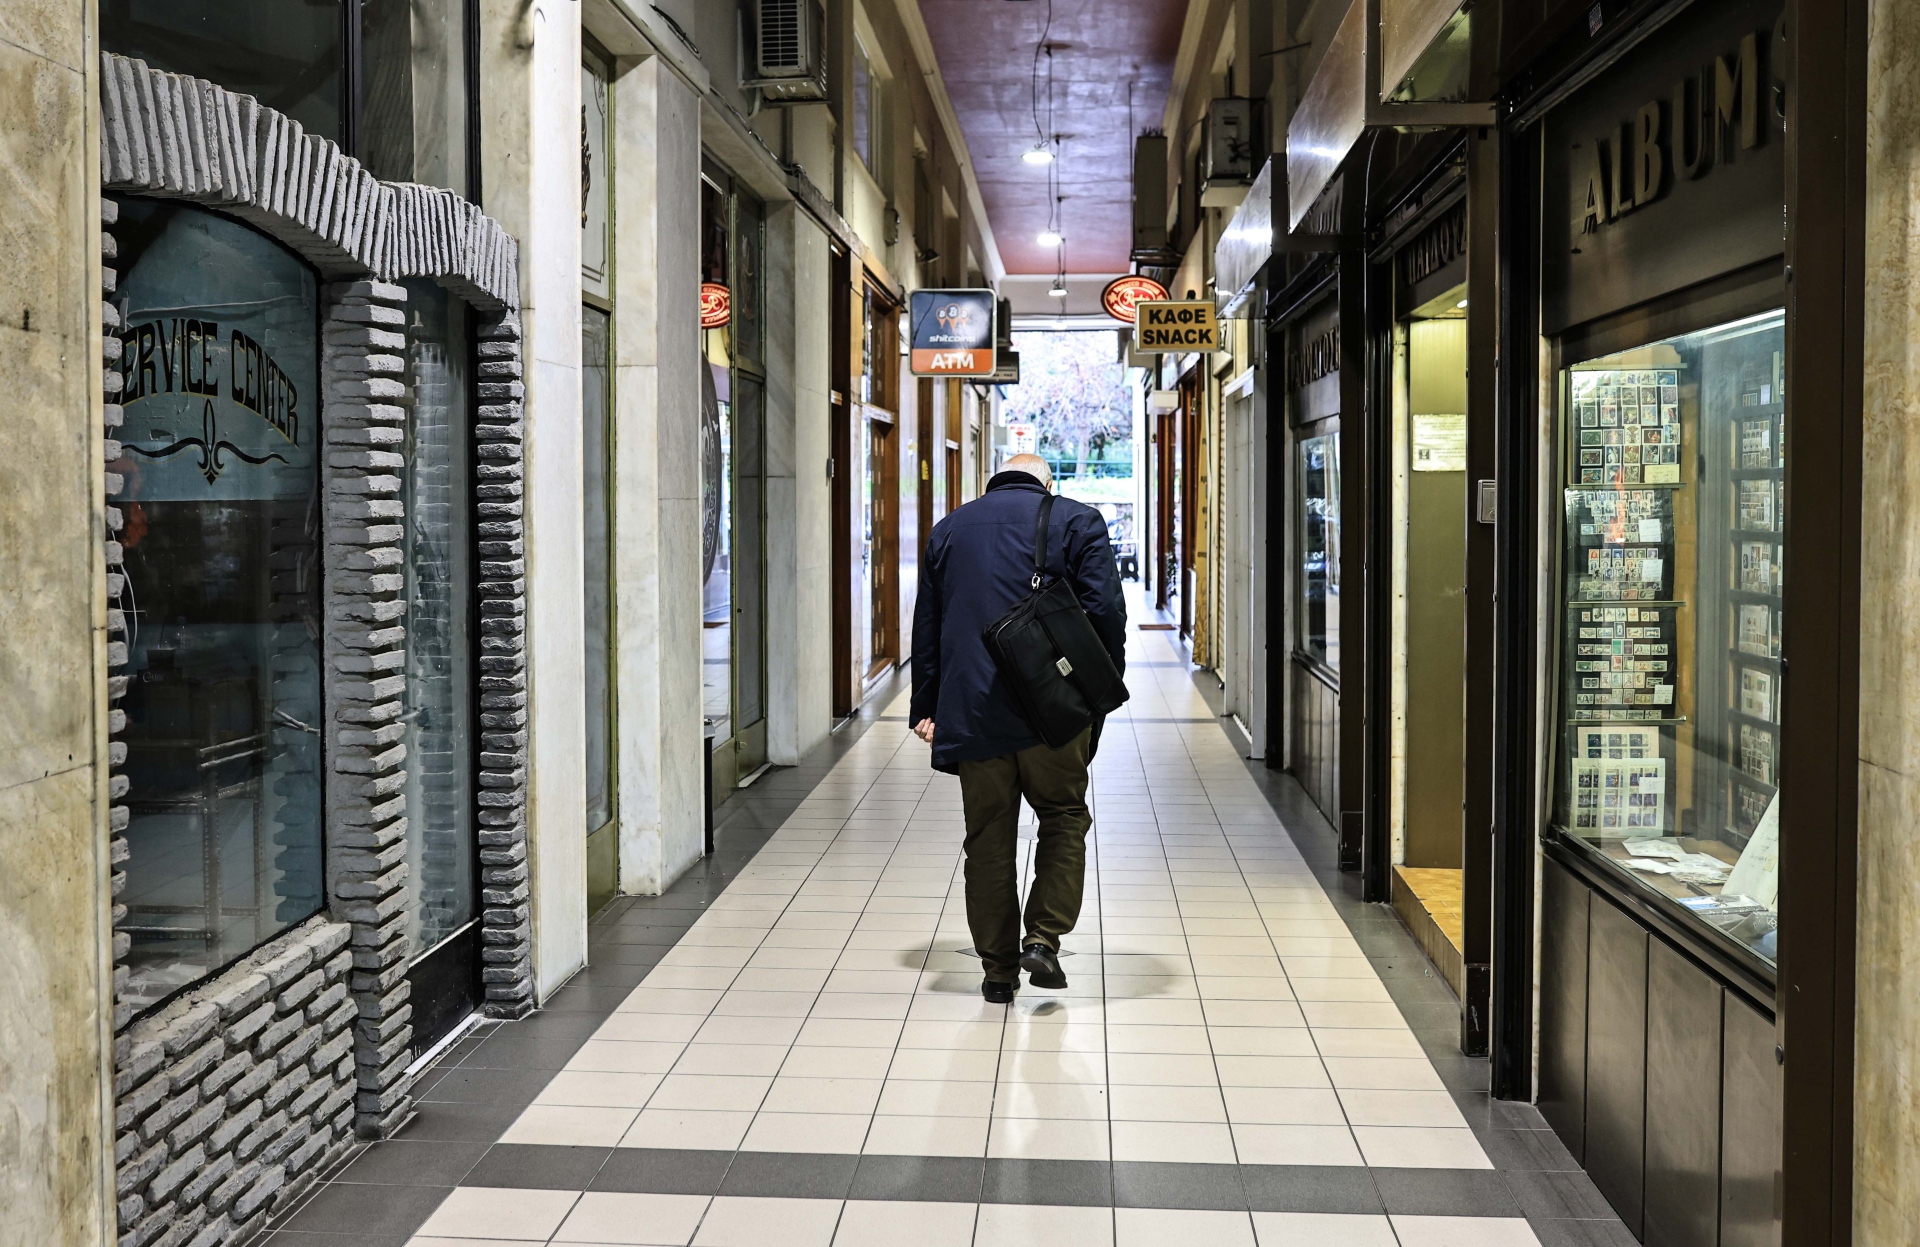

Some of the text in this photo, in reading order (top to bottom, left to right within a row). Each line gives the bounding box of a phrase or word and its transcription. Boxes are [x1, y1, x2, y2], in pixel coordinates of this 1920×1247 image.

[1149, 309, 1206, 324] ΚΑΦΕ
[1143, 329, 1212, 344] SNACK
[930, 352, 974, 369] ATM
[113, 318, 299, 449] ERVICE CENTER
